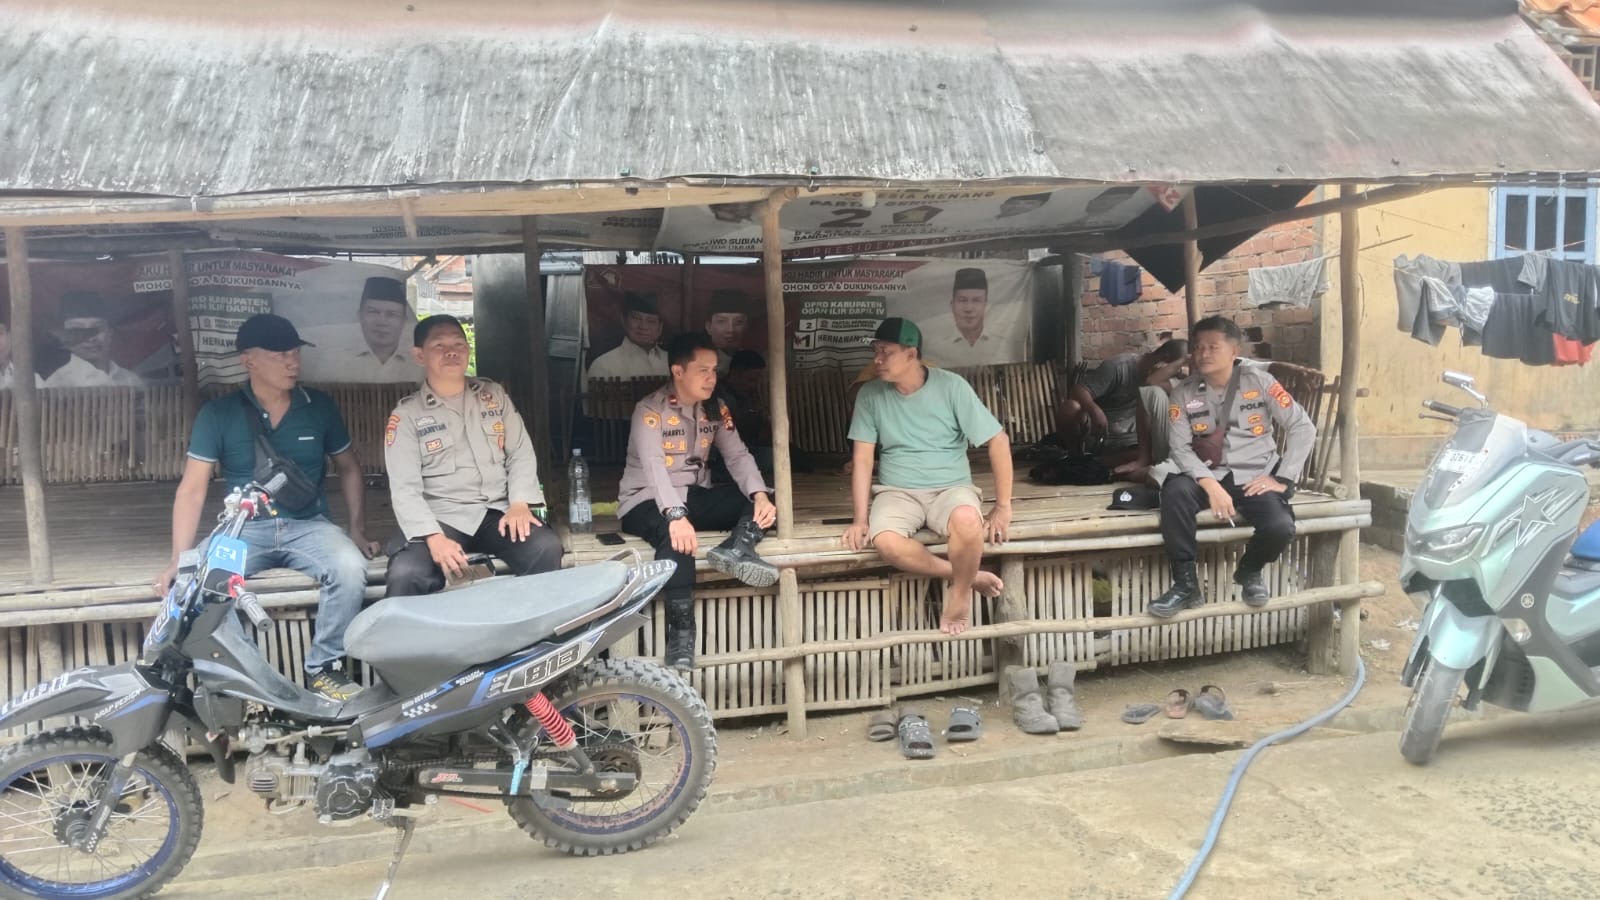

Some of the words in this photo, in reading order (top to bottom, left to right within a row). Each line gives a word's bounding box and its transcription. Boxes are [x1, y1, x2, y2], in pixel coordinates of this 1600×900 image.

[819, 208, 872, 228] 2
[812, 241, 897, 256] PRESIDEN
[198, 261, 231, 272] UNTUK
[231, 262, 297, 277] MASYARAKAT
[825, 269, 853, 278] UNTUK
[854, 268, 905, 278] MASYARAKAT
[220, 278, 303, 289] DUKUNGANNYA
[812, 283, 835, 291] DO'A
[844, 283, 907, 291] DUKUNGANNYA
[801, 334, 811, 348] 1
